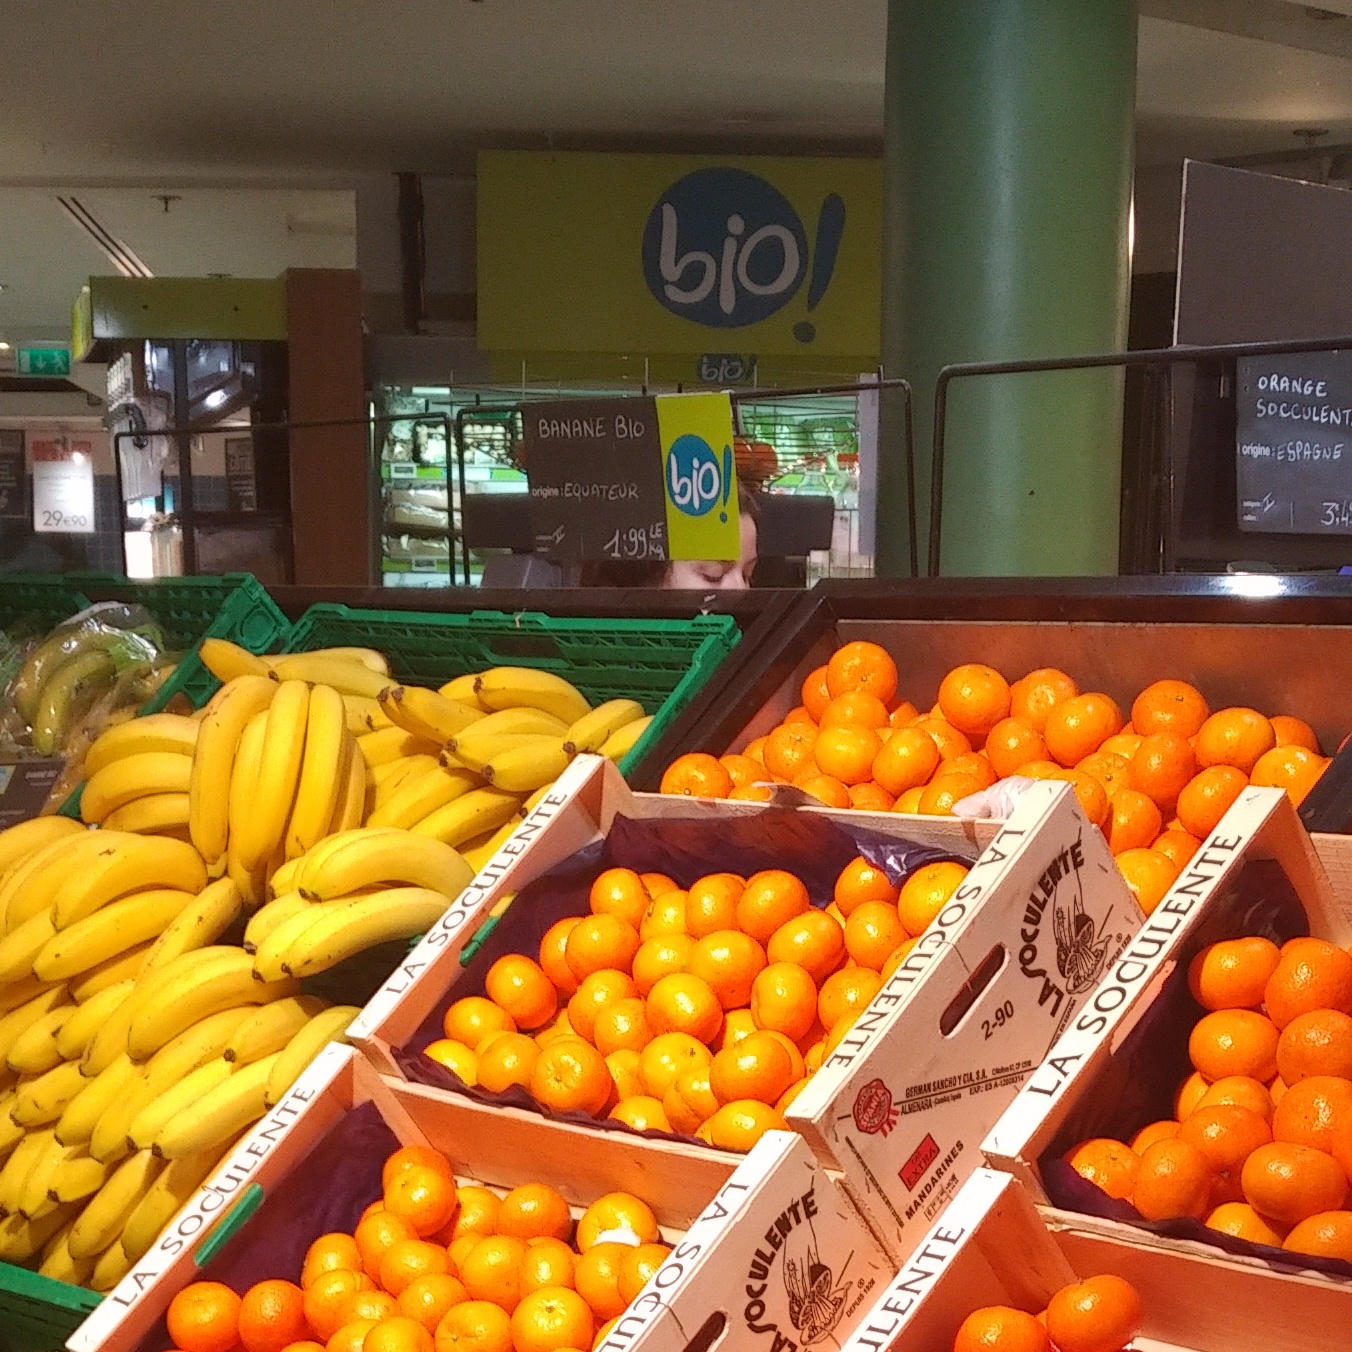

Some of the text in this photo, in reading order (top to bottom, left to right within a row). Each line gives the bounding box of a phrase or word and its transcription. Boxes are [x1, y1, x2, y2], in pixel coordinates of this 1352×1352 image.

[658, 192, 846, 343] bio!
[1258, 374, 1327, 397] ORANGE
[538, 414, 645, 439] BANANE BIO
[1276, 441, 1344, 462] ESPAGNE
[565, 482, 640, 501] EQUATEUR
[670, 443, 733, 524] bio!
[41, 510, 87, 527] 29€90
[649, 522, 664, 538] LE
[385, 791, 569, 997] LA SOCULENTE
[1018, 828, 1085, 1018] LA SOCULENTE
[825, 826, 1025, 1070] LA SOCULENTE
[1025, 832, 1243, 1099] LA SOCULENTE
[981, 999, 1015, 1041] 2-90
[932, 1076, 958, 1092] SANCHO
[900, 1098, 934, 1116] ALMENARA
[905, 1140, 964, 1219] MANDARINES
[907, 1147, 936, 1187] EXTRA
[113, 1085, 316, 1308] LA SOCULENTE
[701, 1181, 750, 1224] LA
[744, 1177, 819, 1333] SOCULENTE
